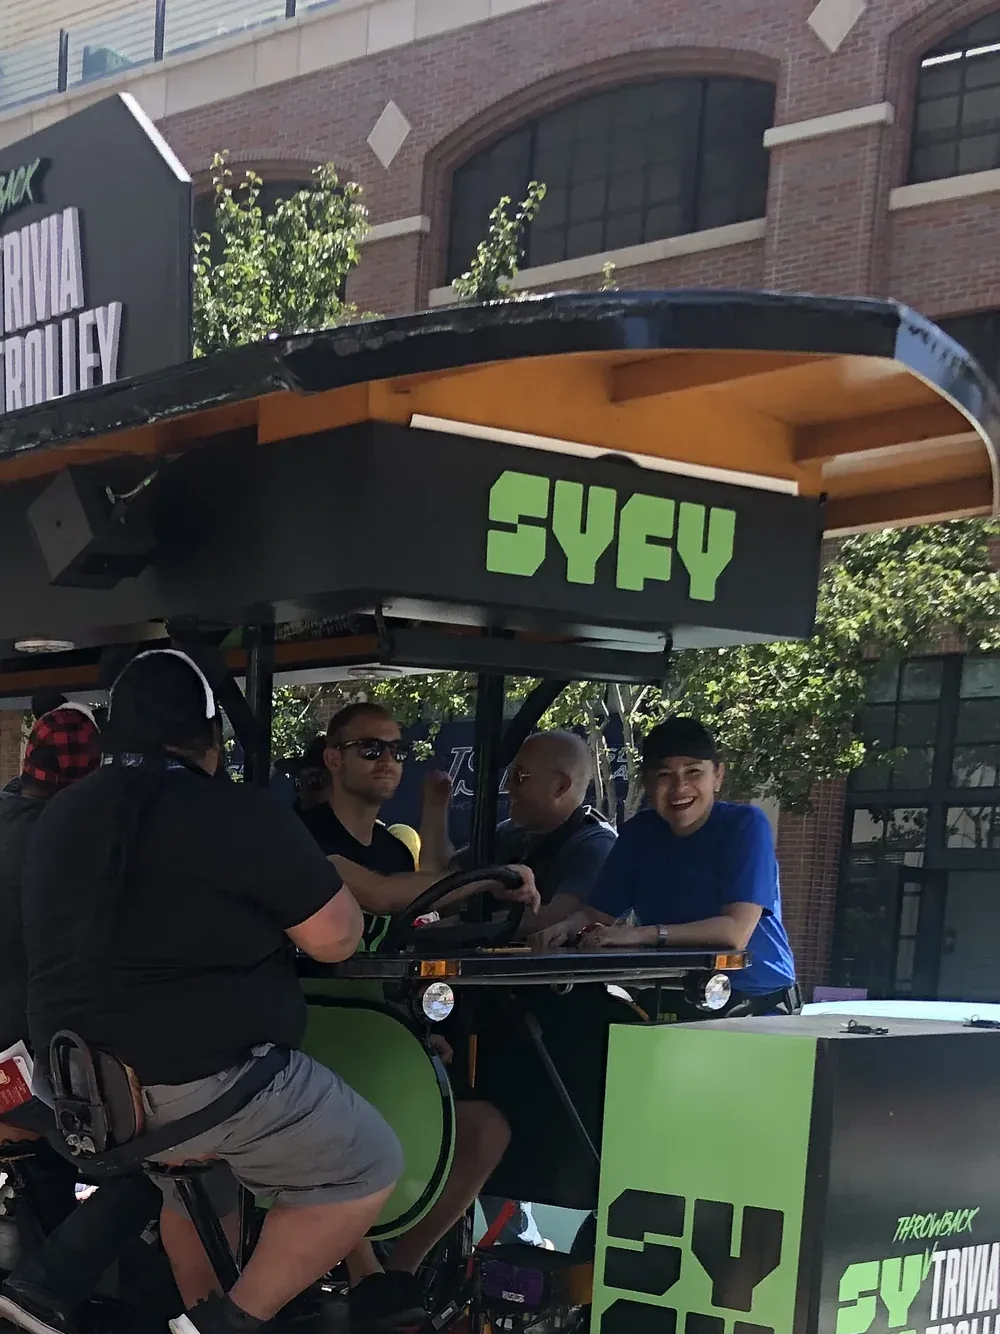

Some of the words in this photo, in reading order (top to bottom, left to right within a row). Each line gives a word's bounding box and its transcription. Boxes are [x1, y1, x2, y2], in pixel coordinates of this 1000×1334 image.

[486, 470, 736, 602] SYFY
[892, 1206, 980, 1245] THROWBACK
[929, 1241, 1000, 1321] TRIVIA
